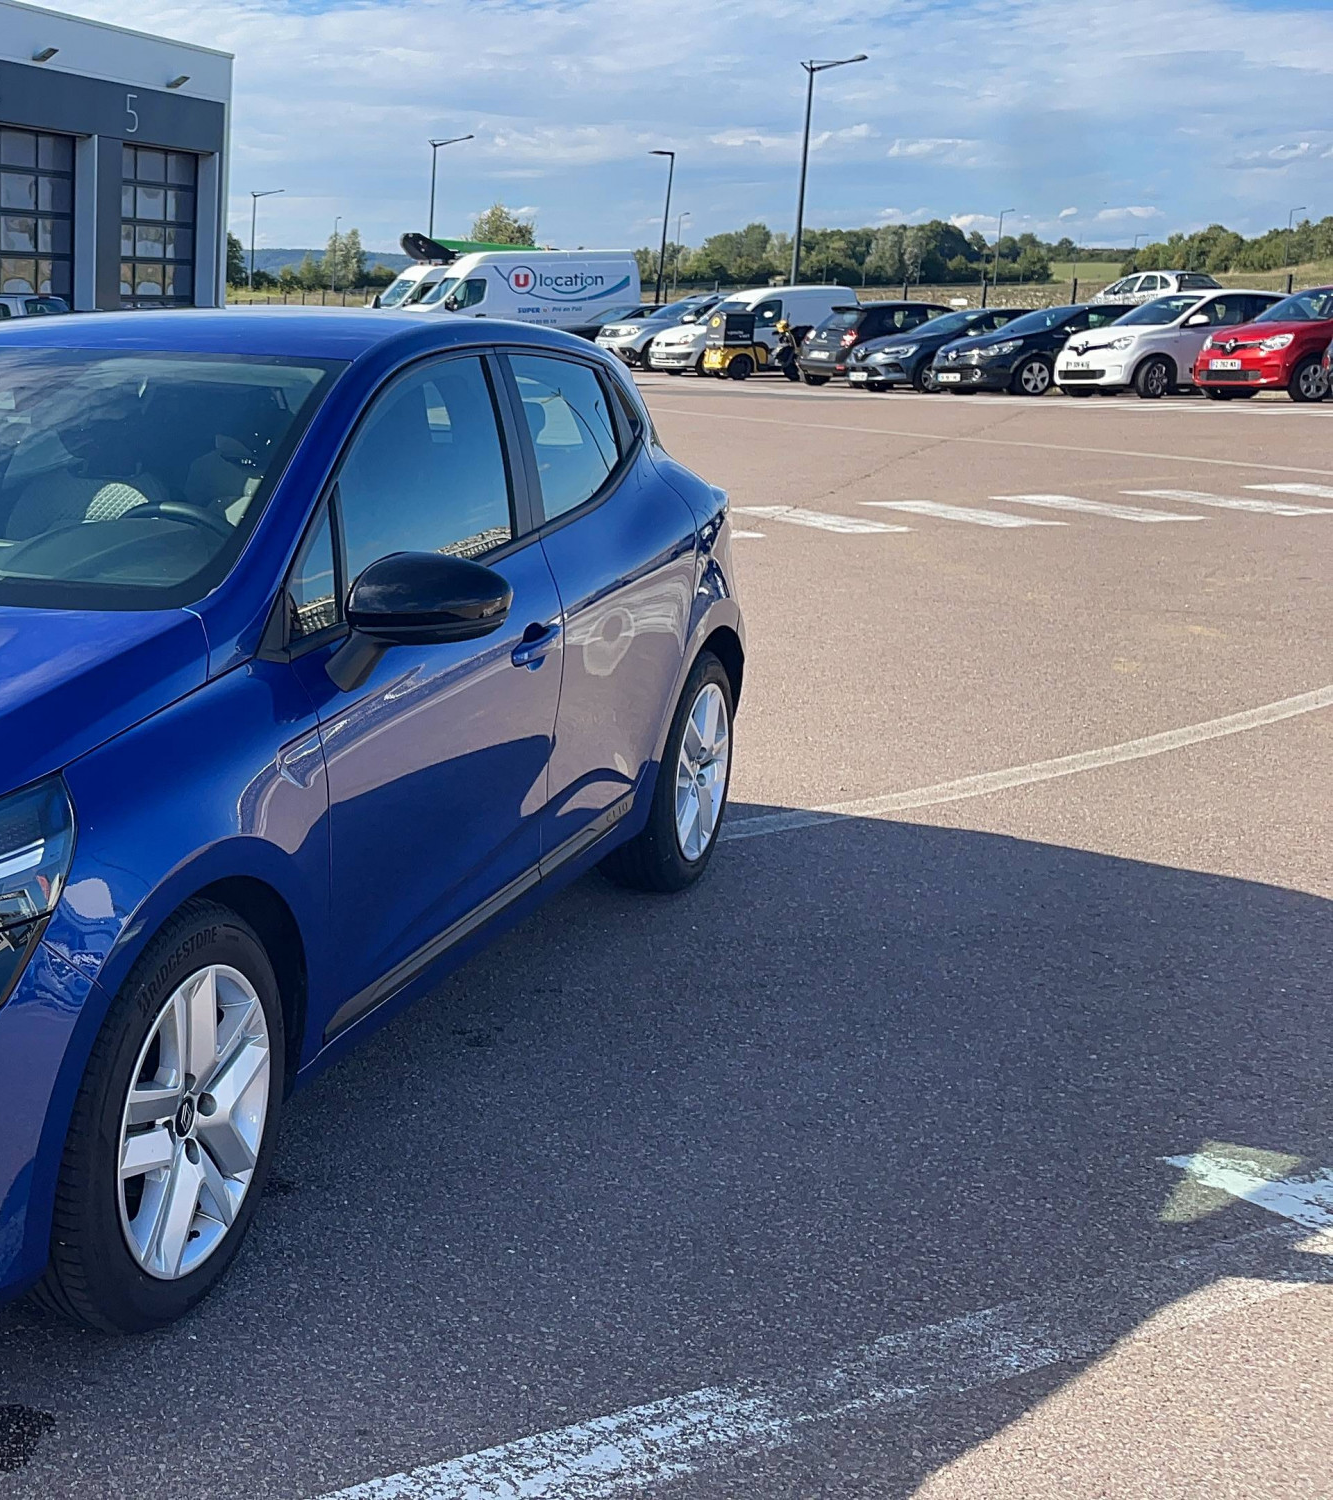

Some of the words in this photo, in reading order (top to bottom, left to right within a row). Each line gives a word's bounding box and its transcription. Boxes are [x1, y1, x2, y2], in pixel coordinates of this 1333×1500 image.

[125, 93, 139, 133] 5
[514, 273, 529, 288] U
[539, 272, 604, 287] location
[137, 925, 218, 1018] BRIDGESTONE
